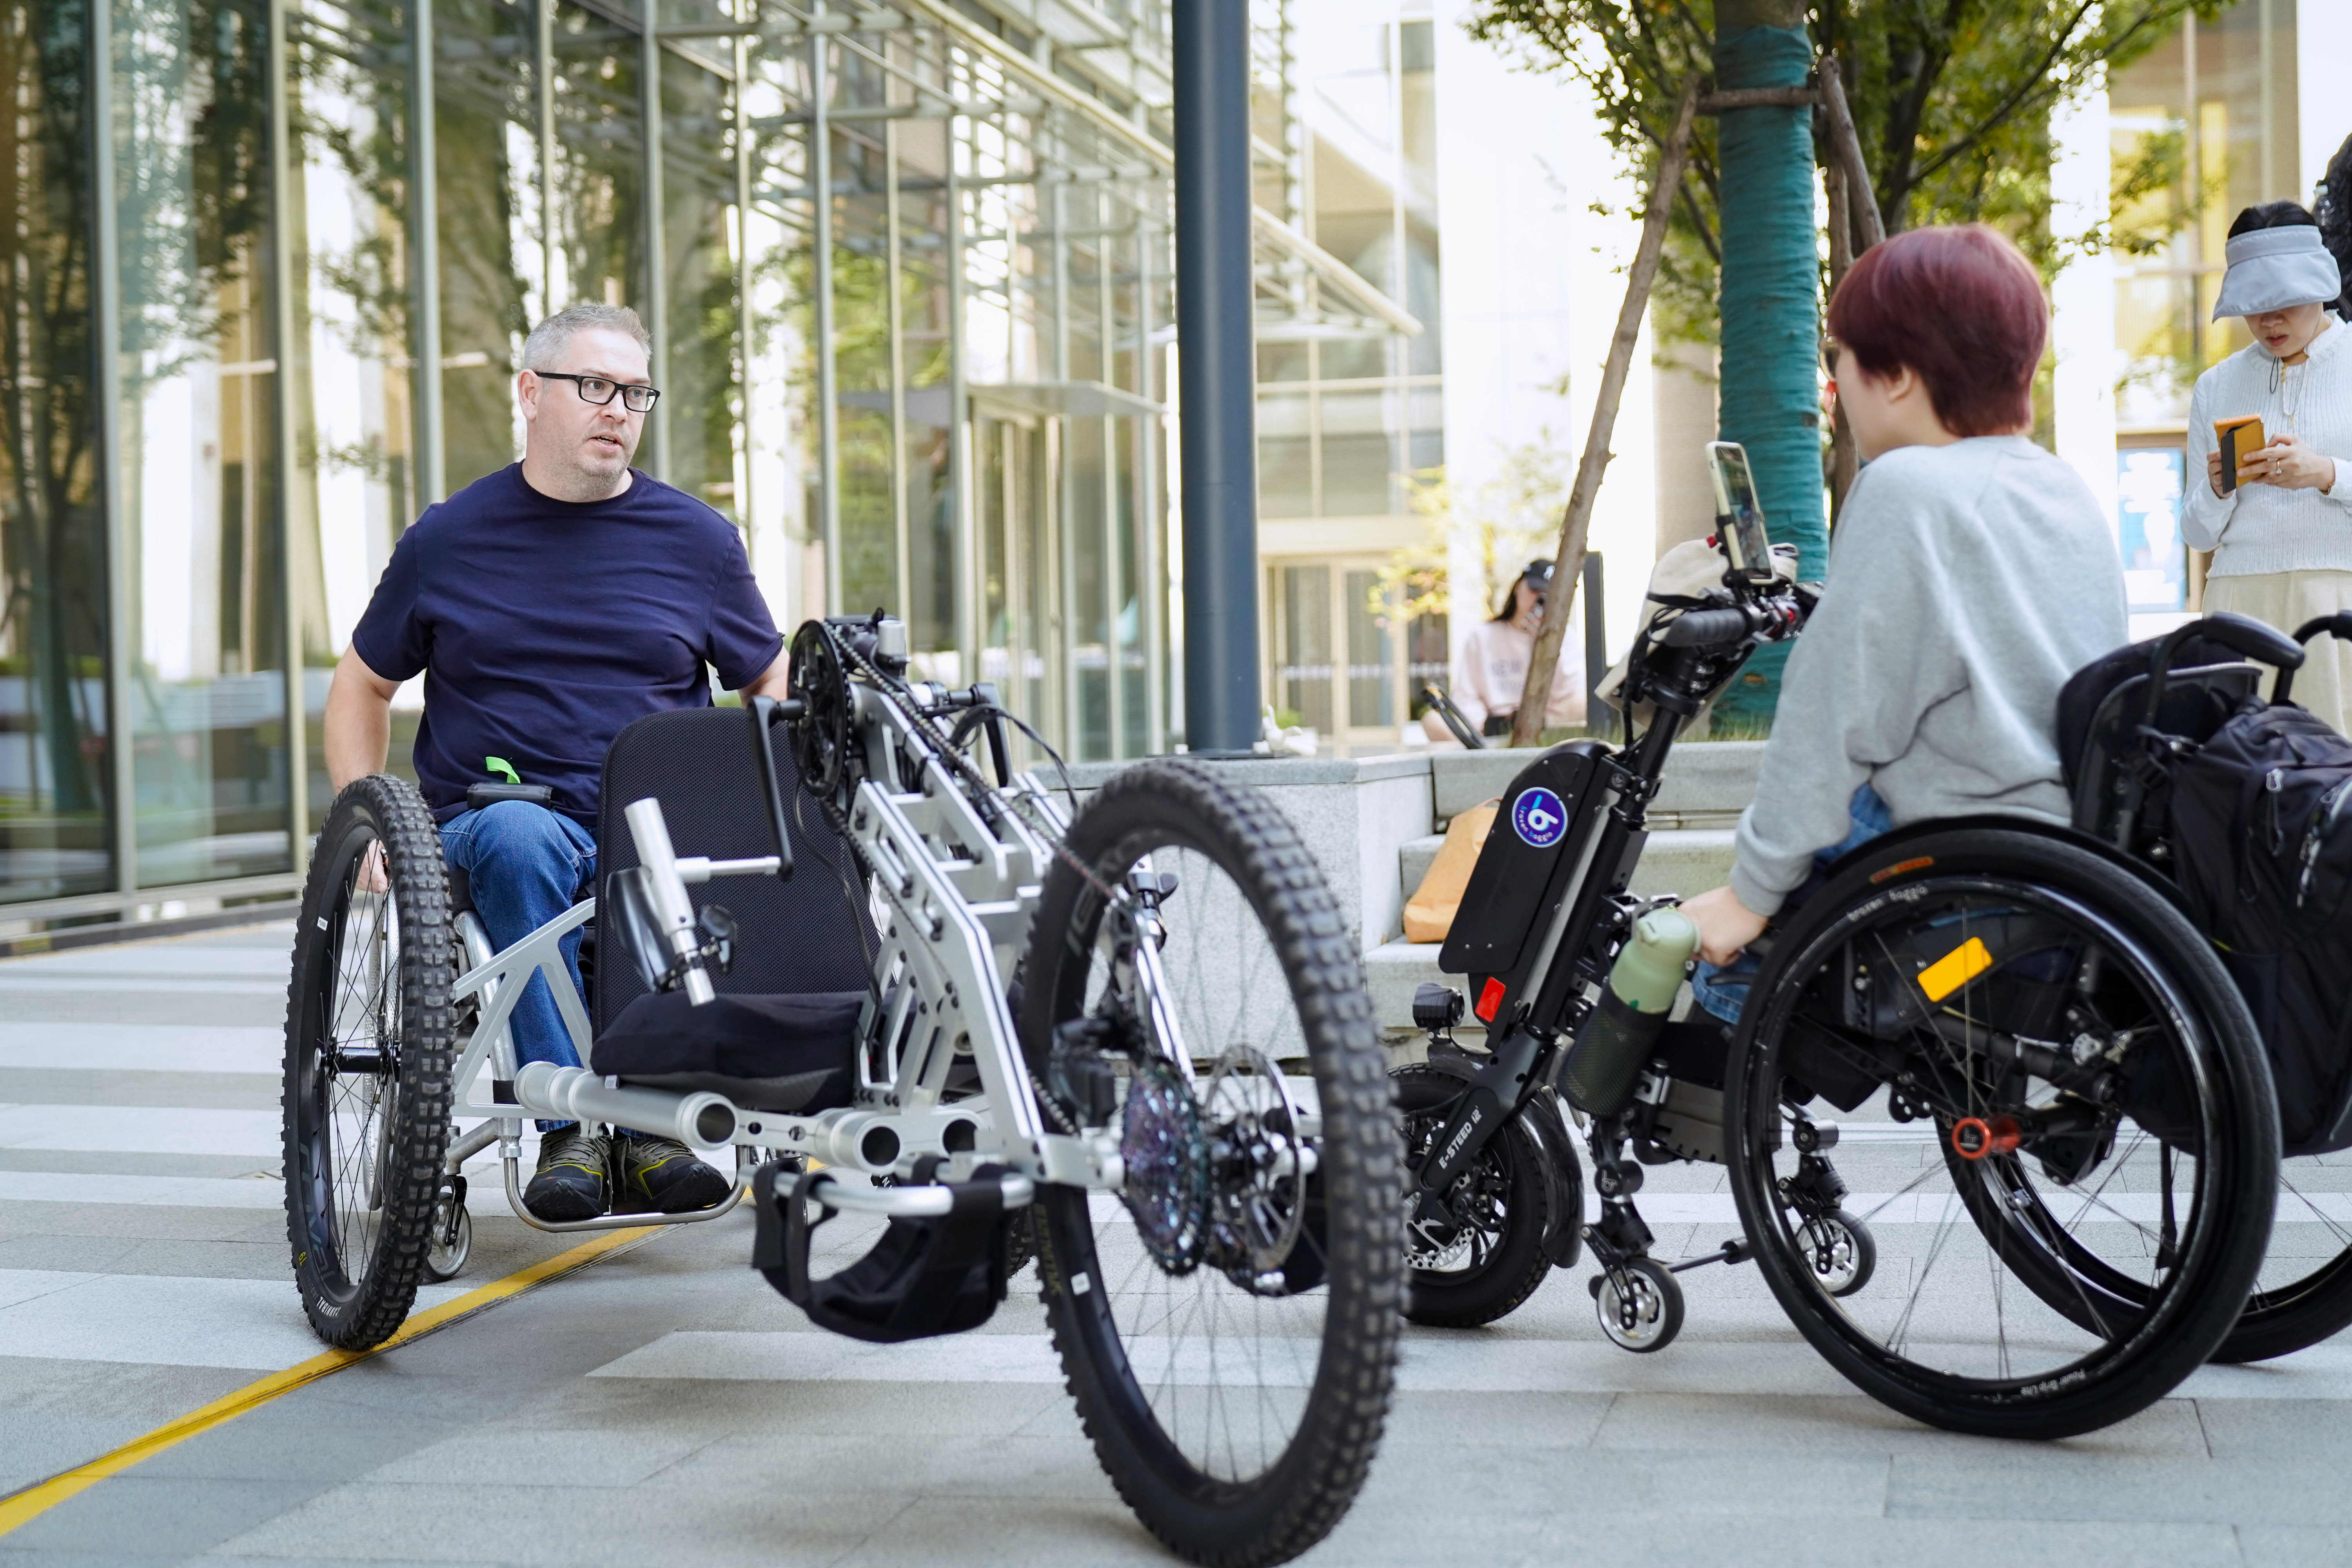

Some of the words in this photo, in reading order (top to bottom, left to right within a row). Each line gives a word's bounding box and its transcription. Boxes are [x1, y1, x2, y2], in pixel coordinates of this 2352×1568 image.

[1519, 806, 1528, 832] braxen
[1529, 830, 1553, 842] baggio
[1438, 1121, 1473, 1170] E-STEED
[316, 1296, 342, 1317] CANNIBAL
[2038, 1379, 2059, 1392] Grip
[2058, 1368, 2087, 1385] Power
[2020, 1385, 2040, 1396] Lite
